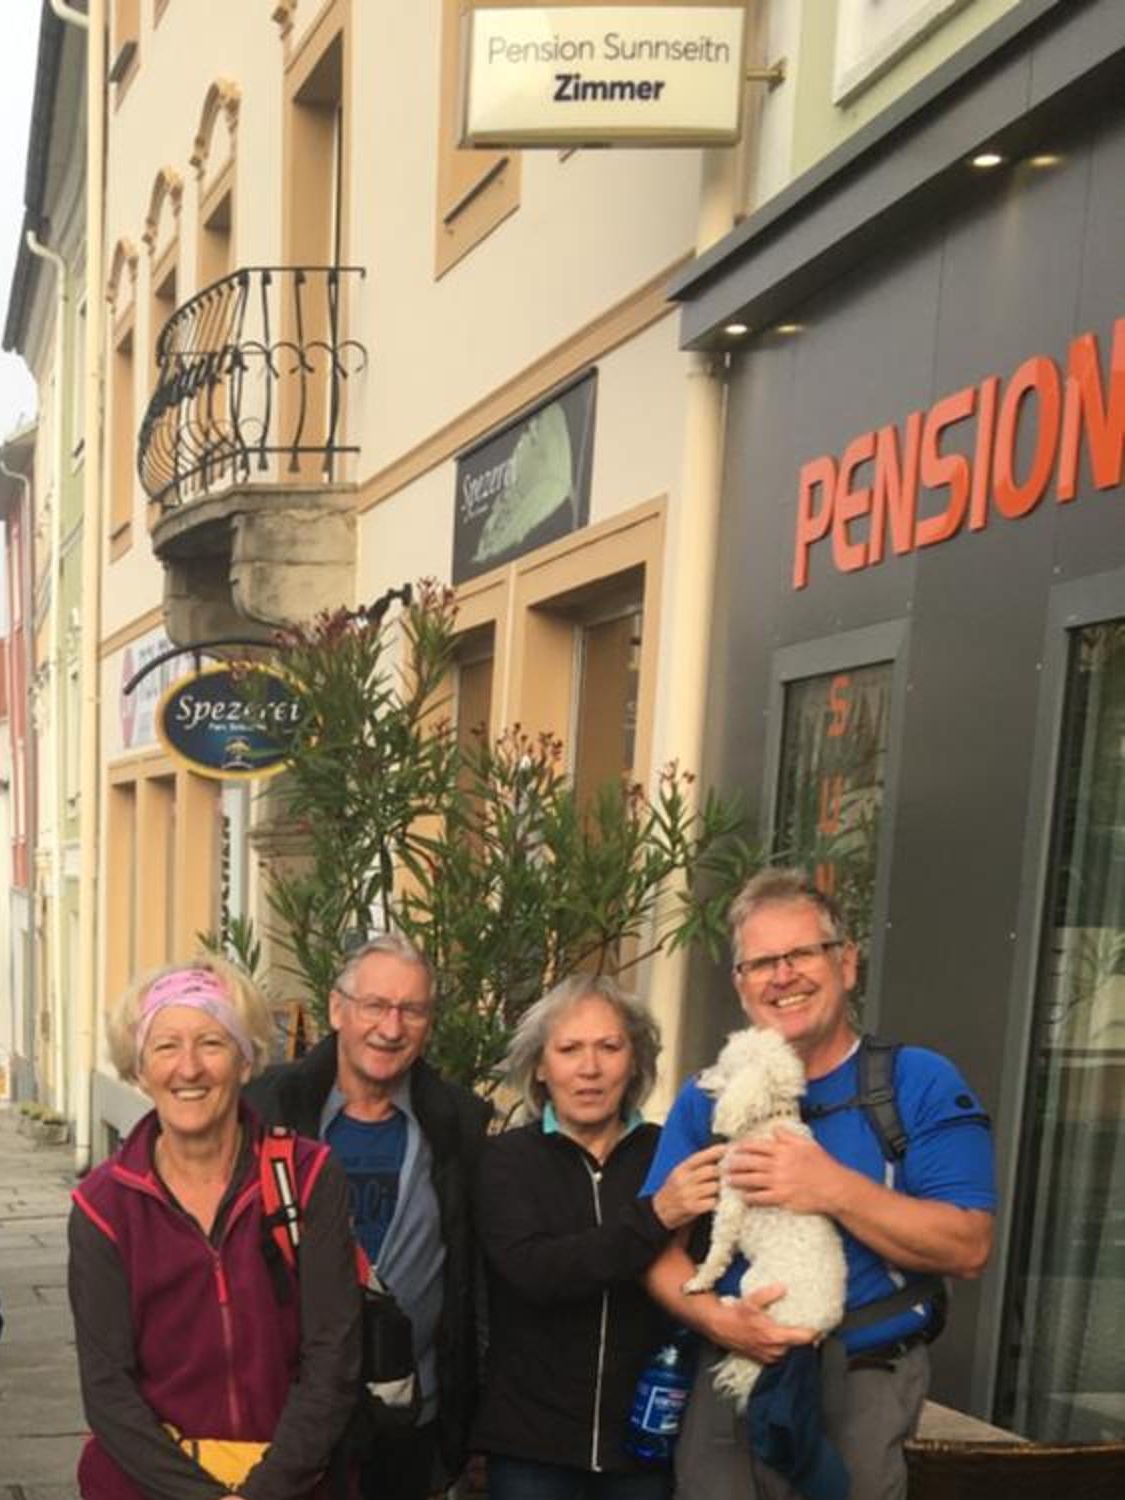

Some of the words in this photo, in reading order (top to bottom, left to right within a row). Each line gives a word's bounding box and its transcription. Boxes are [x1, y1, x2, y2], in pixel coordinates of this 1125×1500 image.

[488, 35, 594, 64] Pension
[604, 33, 729, 62] Sunnseitn
[554, 73, 665, 102] Zimmer
[793, 316, 1125, 590] PENSION
